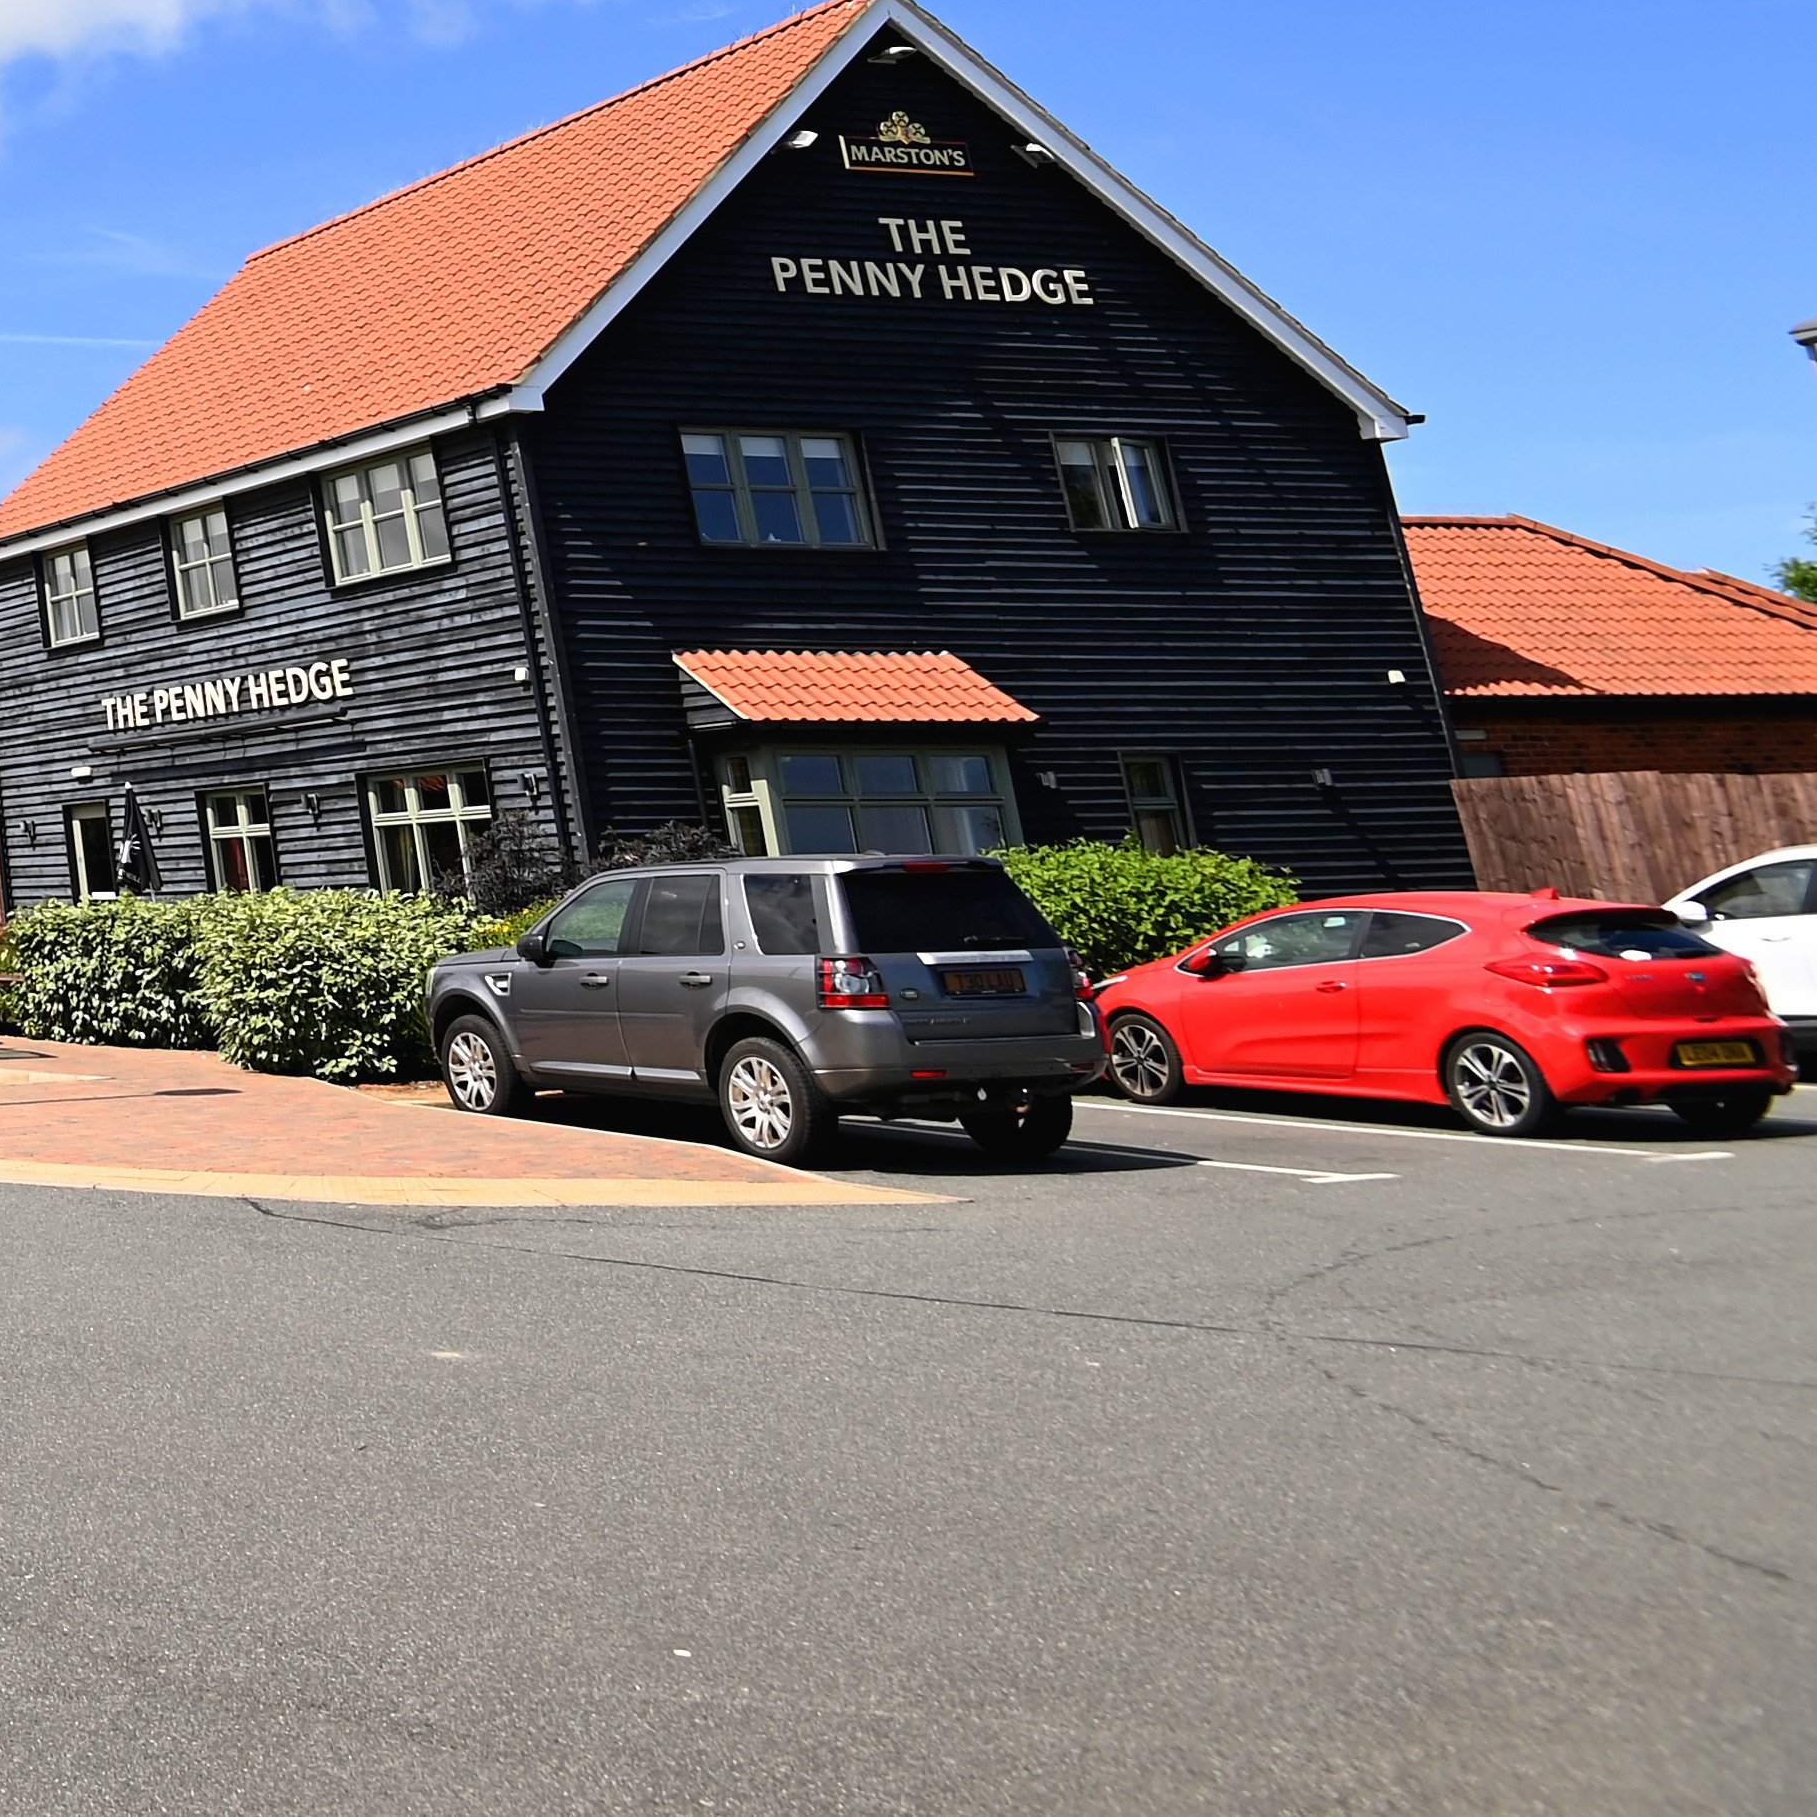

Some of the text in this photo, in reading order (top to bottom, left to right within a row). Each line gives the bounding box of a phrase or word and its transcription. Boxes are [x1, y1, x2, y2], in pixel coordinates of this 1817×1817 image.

[850, 144, 966, 168] MARSTON'S
[877, 217, 972, 256] THE
[770, 256, 1095, 306] PENNY HEDGE
[101, 658, 354, 730] THE PENNY HEDGE
